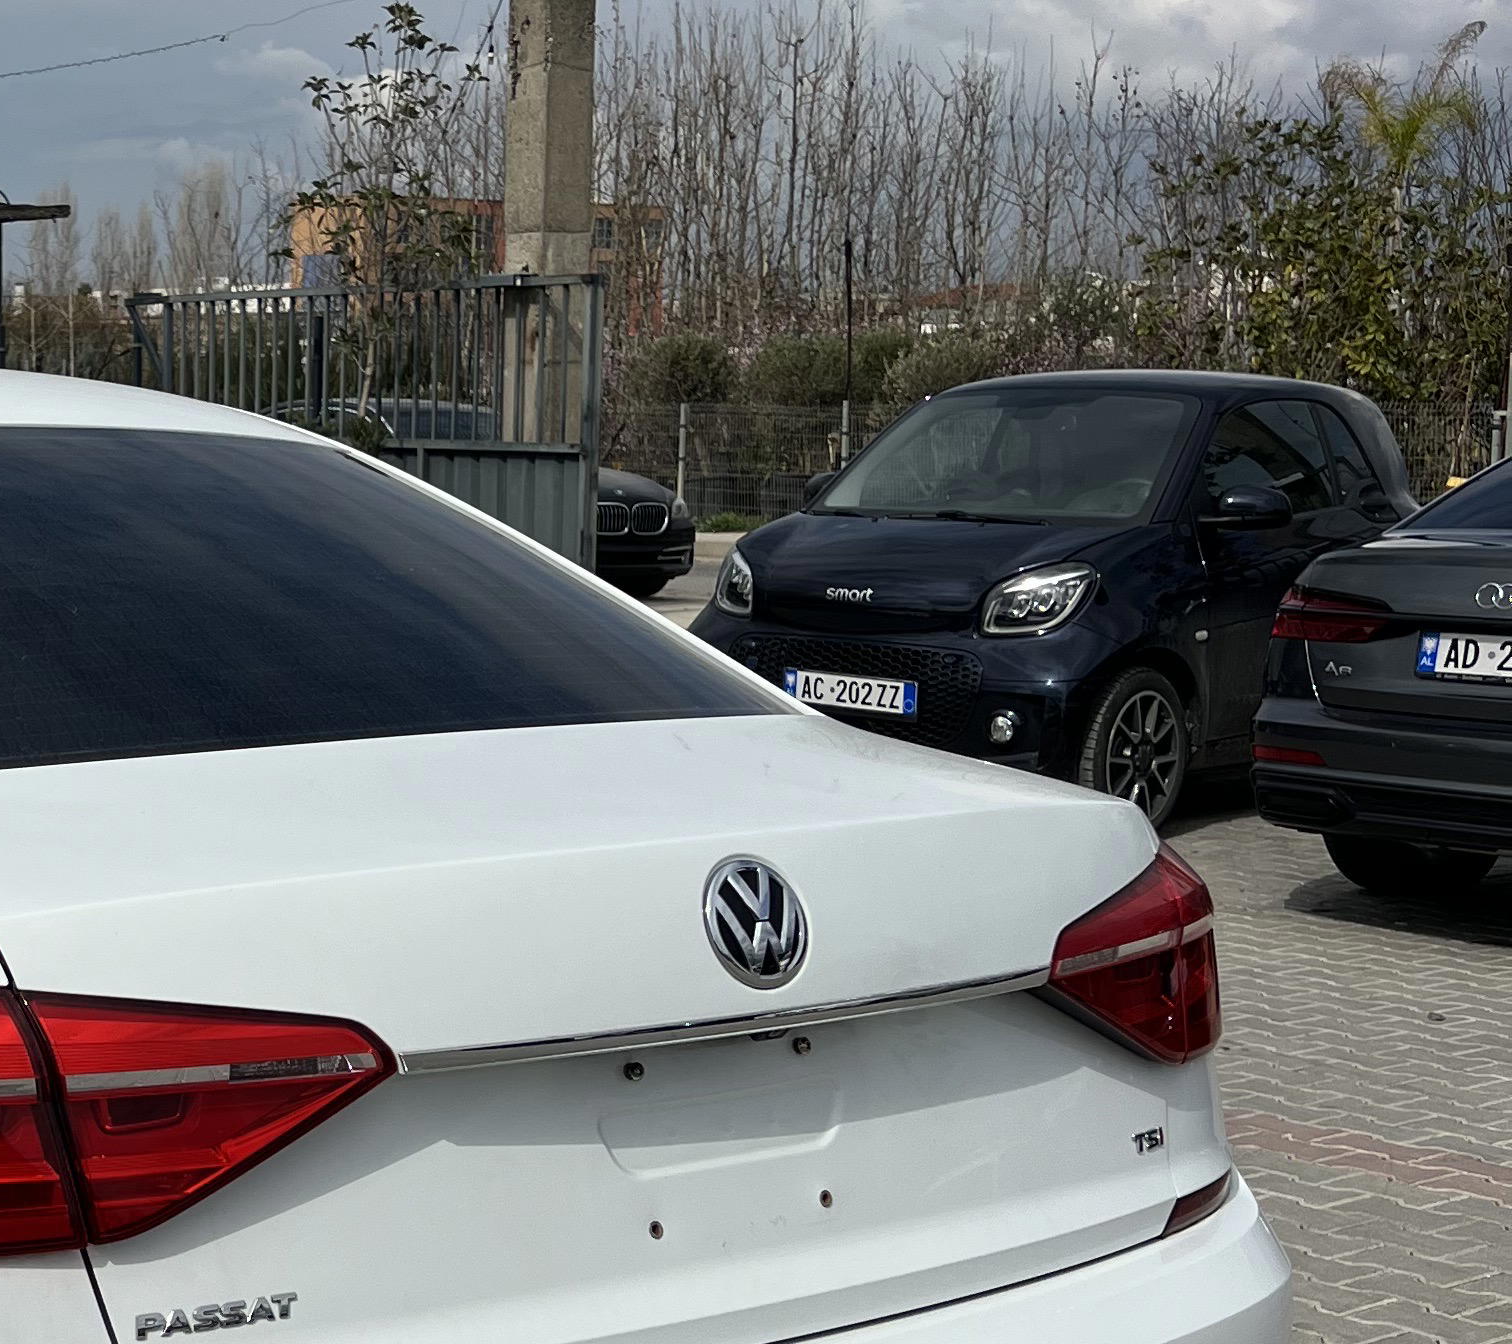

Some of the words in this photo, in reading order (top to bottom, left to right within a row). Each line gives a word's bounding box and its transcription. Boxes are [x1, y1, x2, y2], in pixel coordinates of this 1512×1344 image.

[825, 587, 875, 602] smart
[1419, 656, 1434, 666] AL
[1443, 638, 1480, 668] AD
[801, 675, 825, 700] AC
[1131, 1126, 1164, 1155] TSI
[135, 1291, 298, 1341] PASSAT
